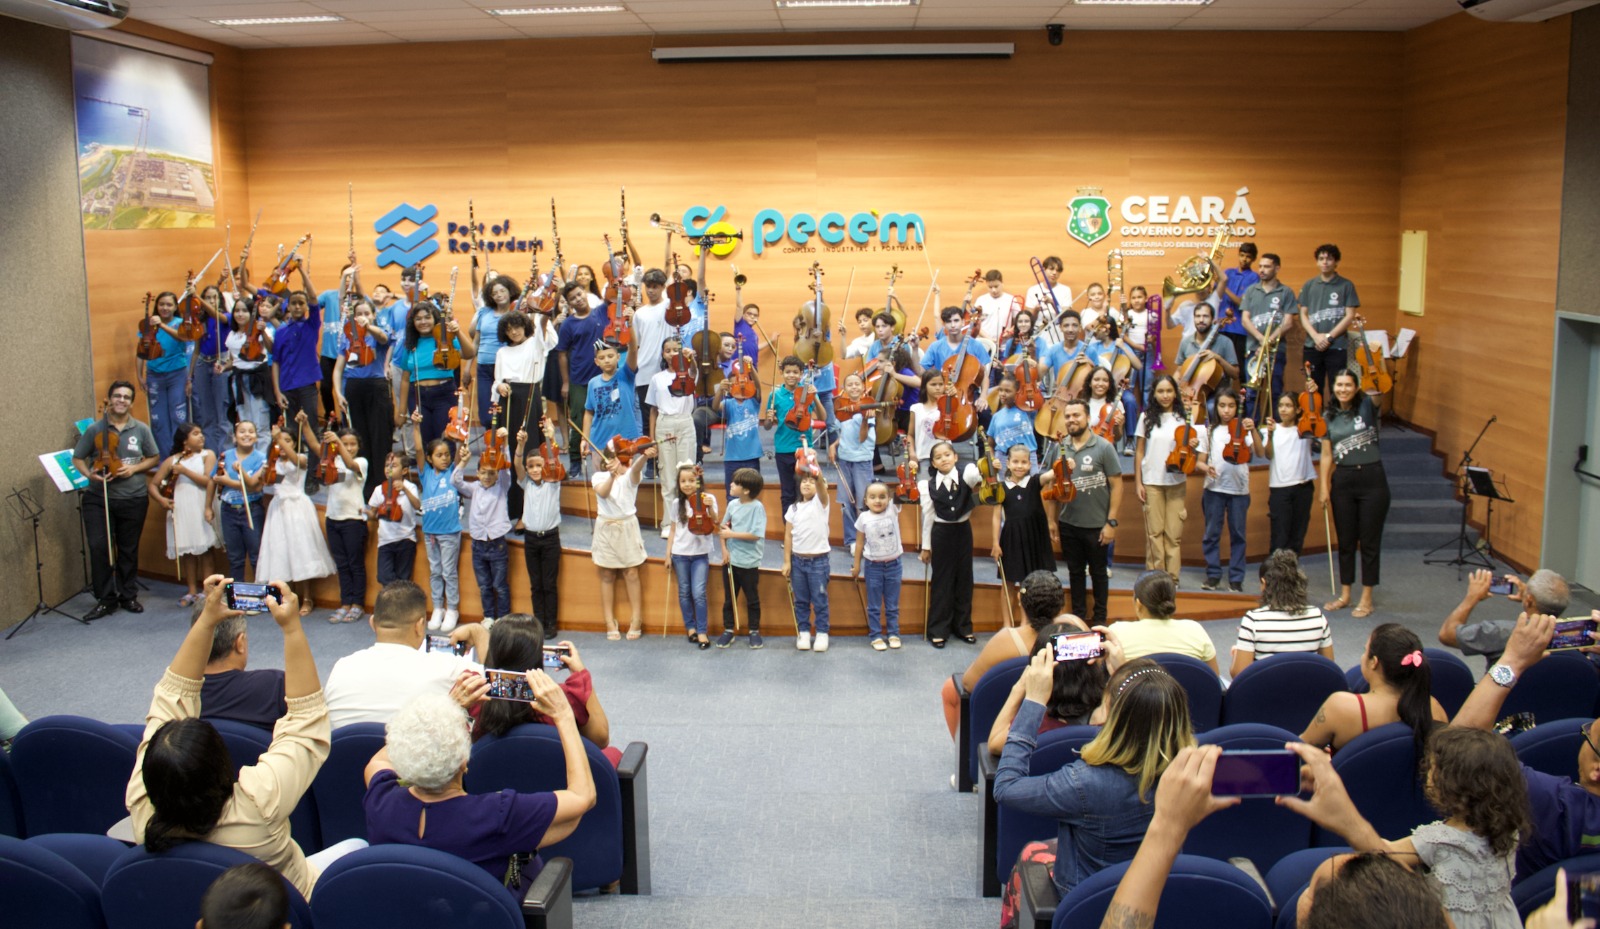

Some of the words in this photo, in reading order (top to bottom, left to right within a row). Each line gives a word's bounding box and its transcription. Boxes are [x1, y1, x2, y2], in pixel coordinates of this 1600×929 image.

[1120, 186, 1256, 224] CEARÁ
[447, 222, 485, 236] Pot
[491, 219, 510, 237] of
[752, 207, 925, 254] pecém
[1120, 225, 1183, 236] GOVERNO
[1185, 226, 1205, 237] DO
[448, 236, 543, 254] Roterdam
[1121, 248, 1165, 256] ECONÔMICO
[1175, 241, 1242, 249] DESENVOLENT
